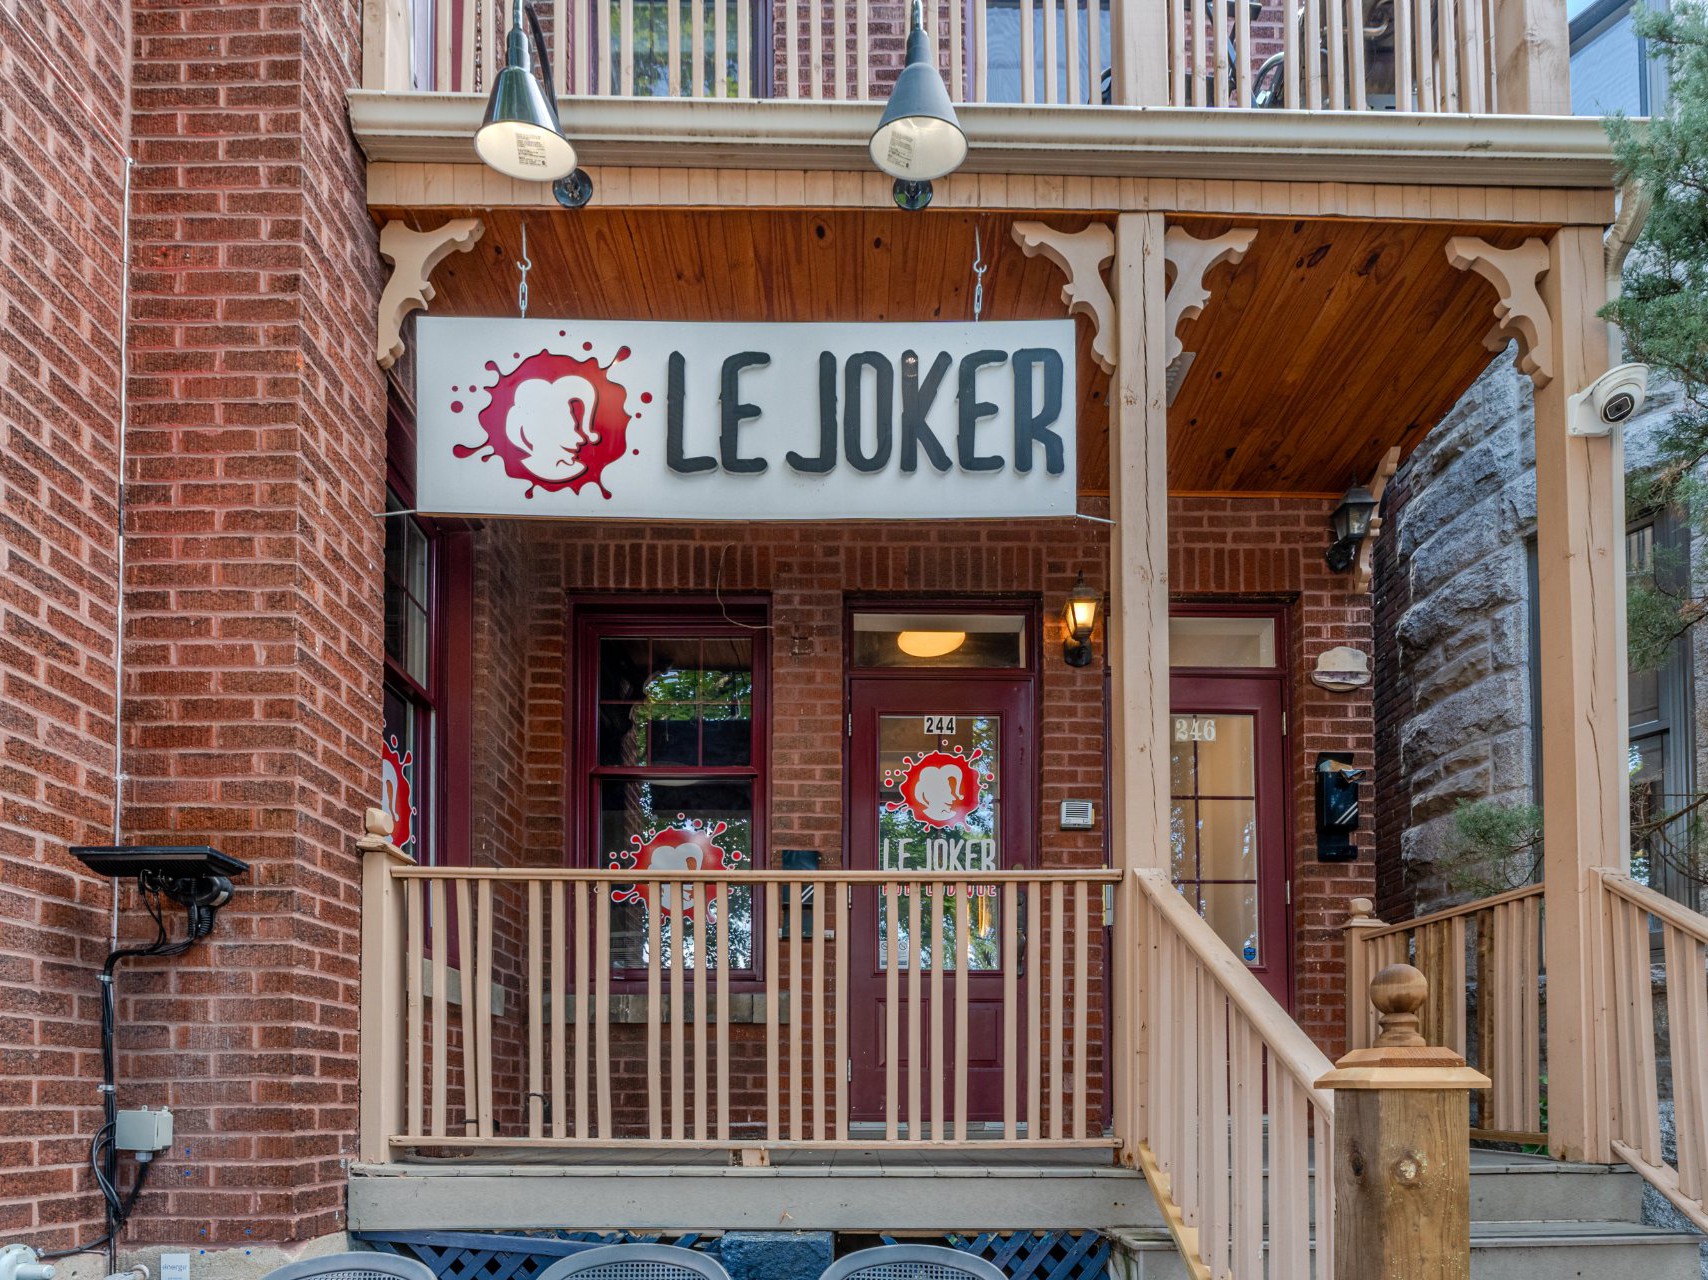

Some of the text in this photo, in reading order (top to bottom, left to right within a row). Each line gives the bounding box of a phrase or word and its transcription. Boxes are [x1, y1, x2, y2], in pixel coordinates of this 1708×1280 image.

[667, 347, 1065, 476] LE JOKER
[926, 717, 954, 733] 244
[1175, 718, 1216, 741] 246
[883, 838, 996, 871] LE JOKER
